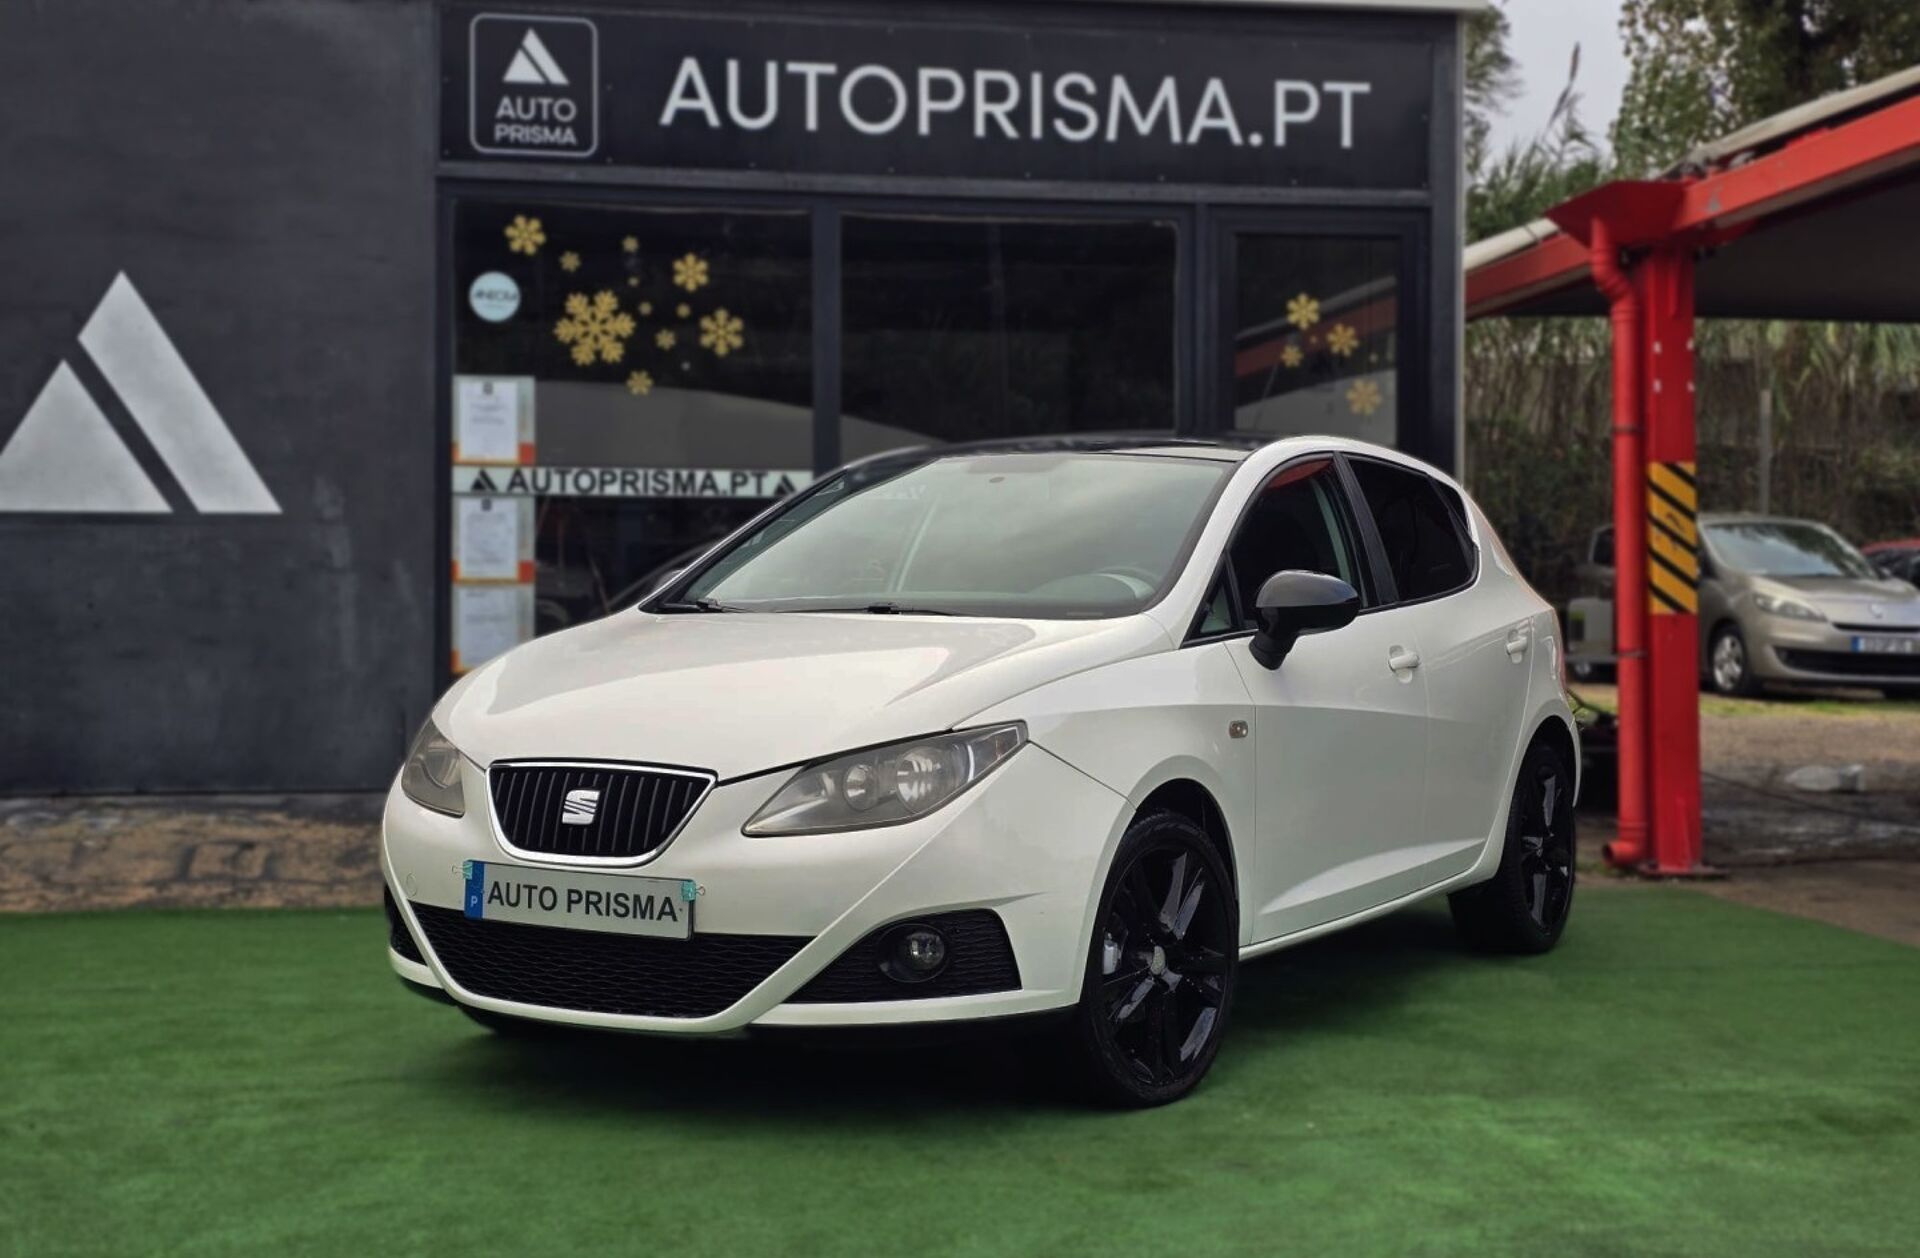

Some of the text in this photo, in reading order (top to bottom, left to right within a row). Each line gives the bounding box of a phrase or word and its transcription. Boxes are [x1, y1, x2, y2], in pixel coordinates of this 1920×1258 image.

[496, 96, 577, 122] AUTO
[660, 57, 1370, 148] AUTOPRISMA.PT
[495, 123, 577, 145] PRISMA
[506, 469, 769, 497] AUTOPRISMA.PT
[470, 895, 478, 908] P
[487, 880, 678, 922] AUTO PRISMA
